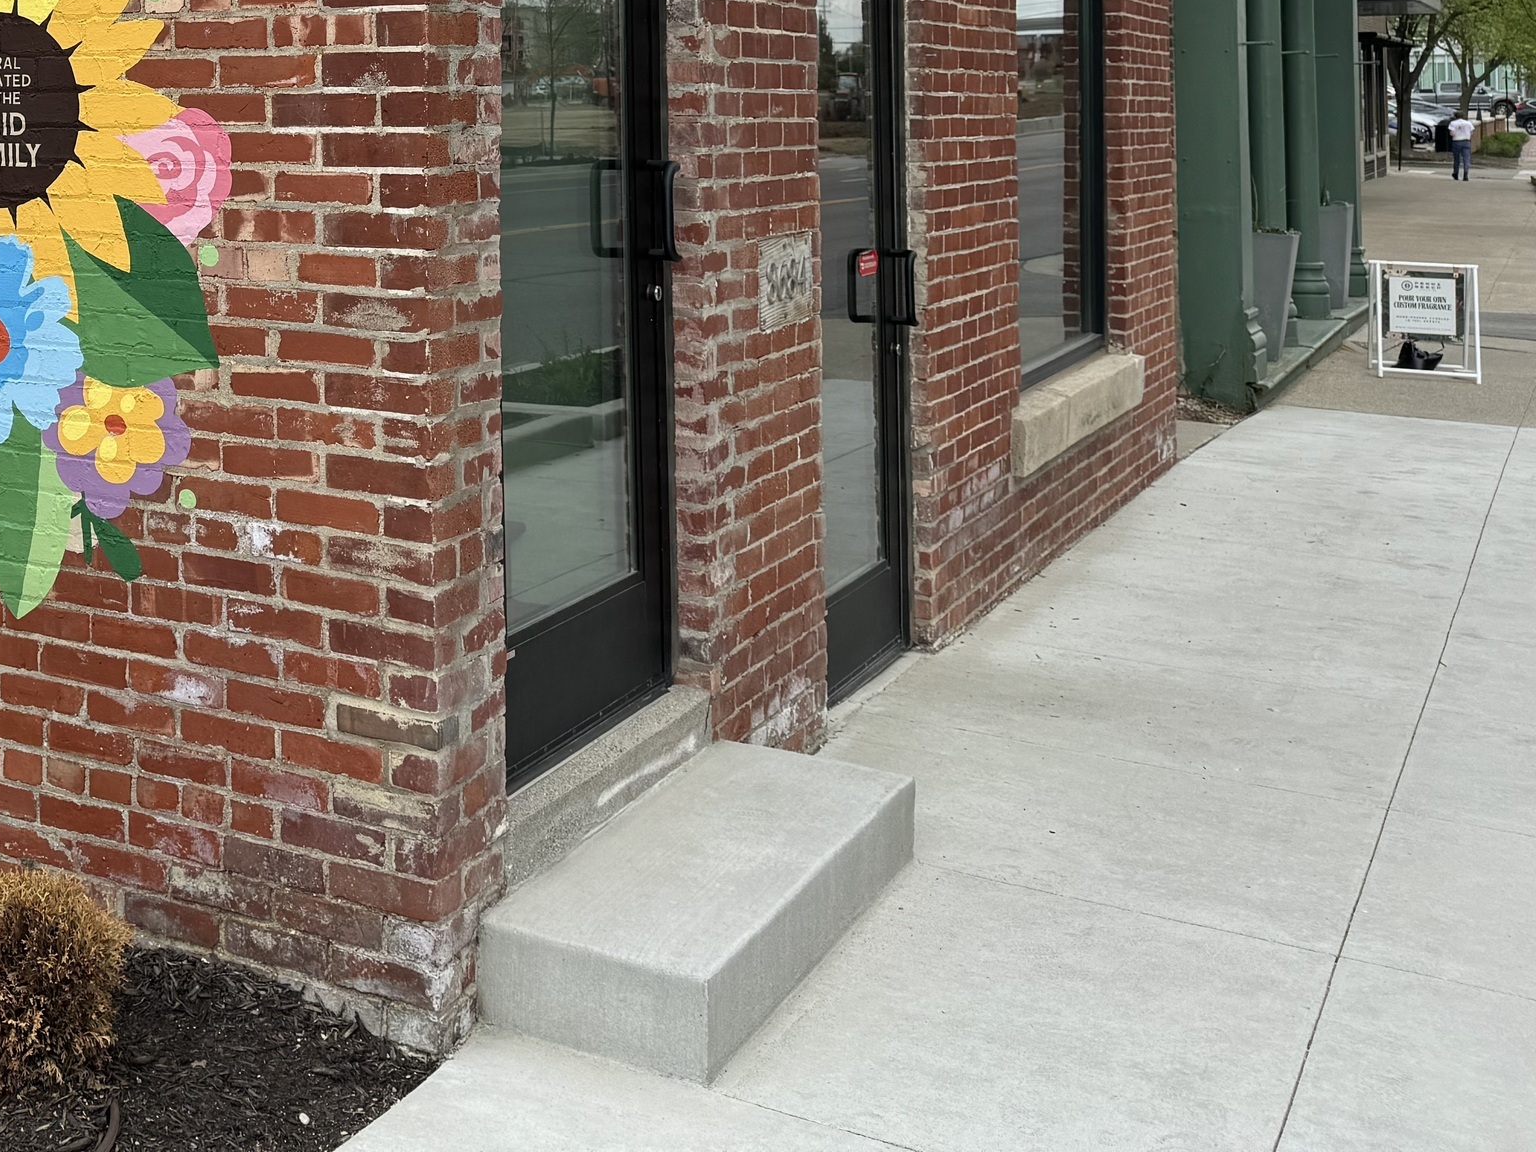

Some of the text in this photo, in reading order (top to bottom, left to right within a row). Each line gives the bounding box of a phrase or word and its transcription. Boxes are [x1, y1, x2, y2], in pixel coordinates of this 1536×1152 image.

[766, 255, 807, 306] 8684
[1398, 294, 1447, 304] POUR YOUR OWN
[1393, 301, 1452, 311] CUSTOM FRAGRANCE
